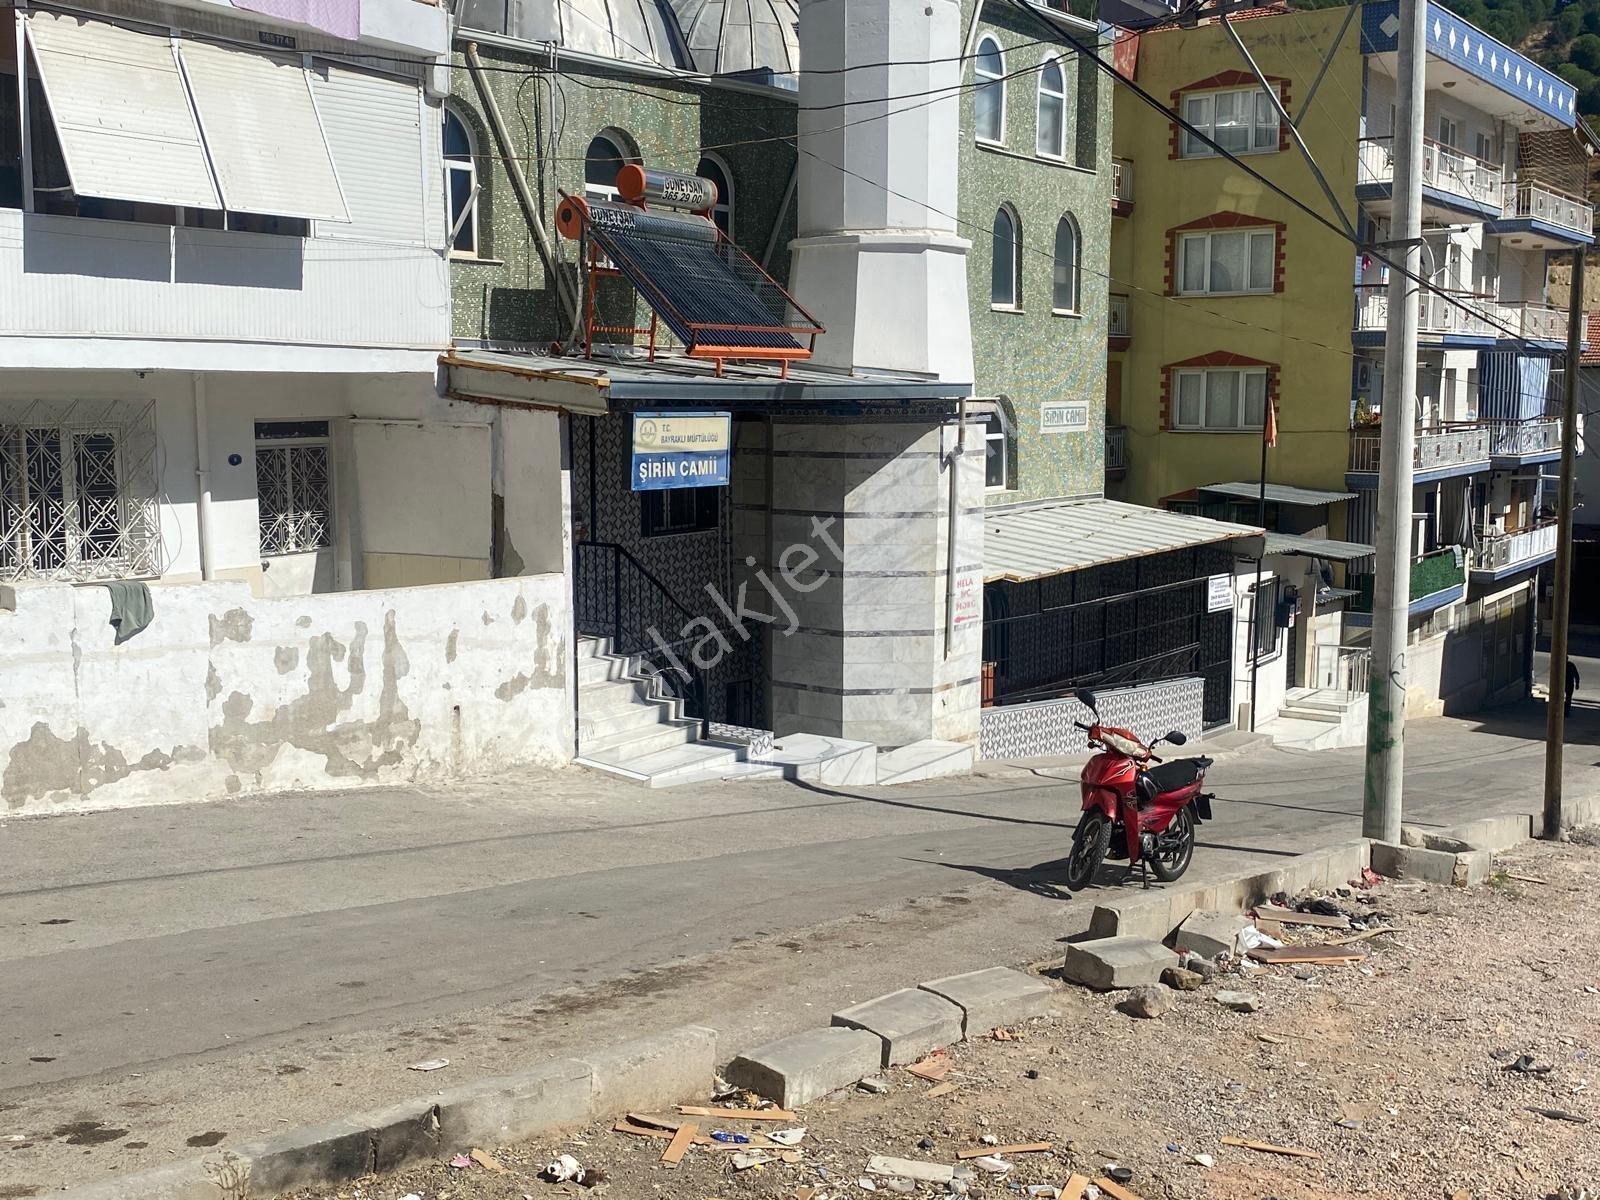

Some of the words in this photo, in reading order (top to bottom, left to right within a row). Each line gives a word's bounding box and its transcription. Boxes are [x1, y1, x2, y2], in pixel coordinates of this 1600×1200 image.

[662, 191, 678, 200] 365
[679, 193, 690, 202] 29
[691, 195, 701, 204] 00
[661, 434, 686, 444] BAYRAKLI
[639, 458, 676, 482] ŞİRİN
[680, 456, 717, 476] CAMİİ
